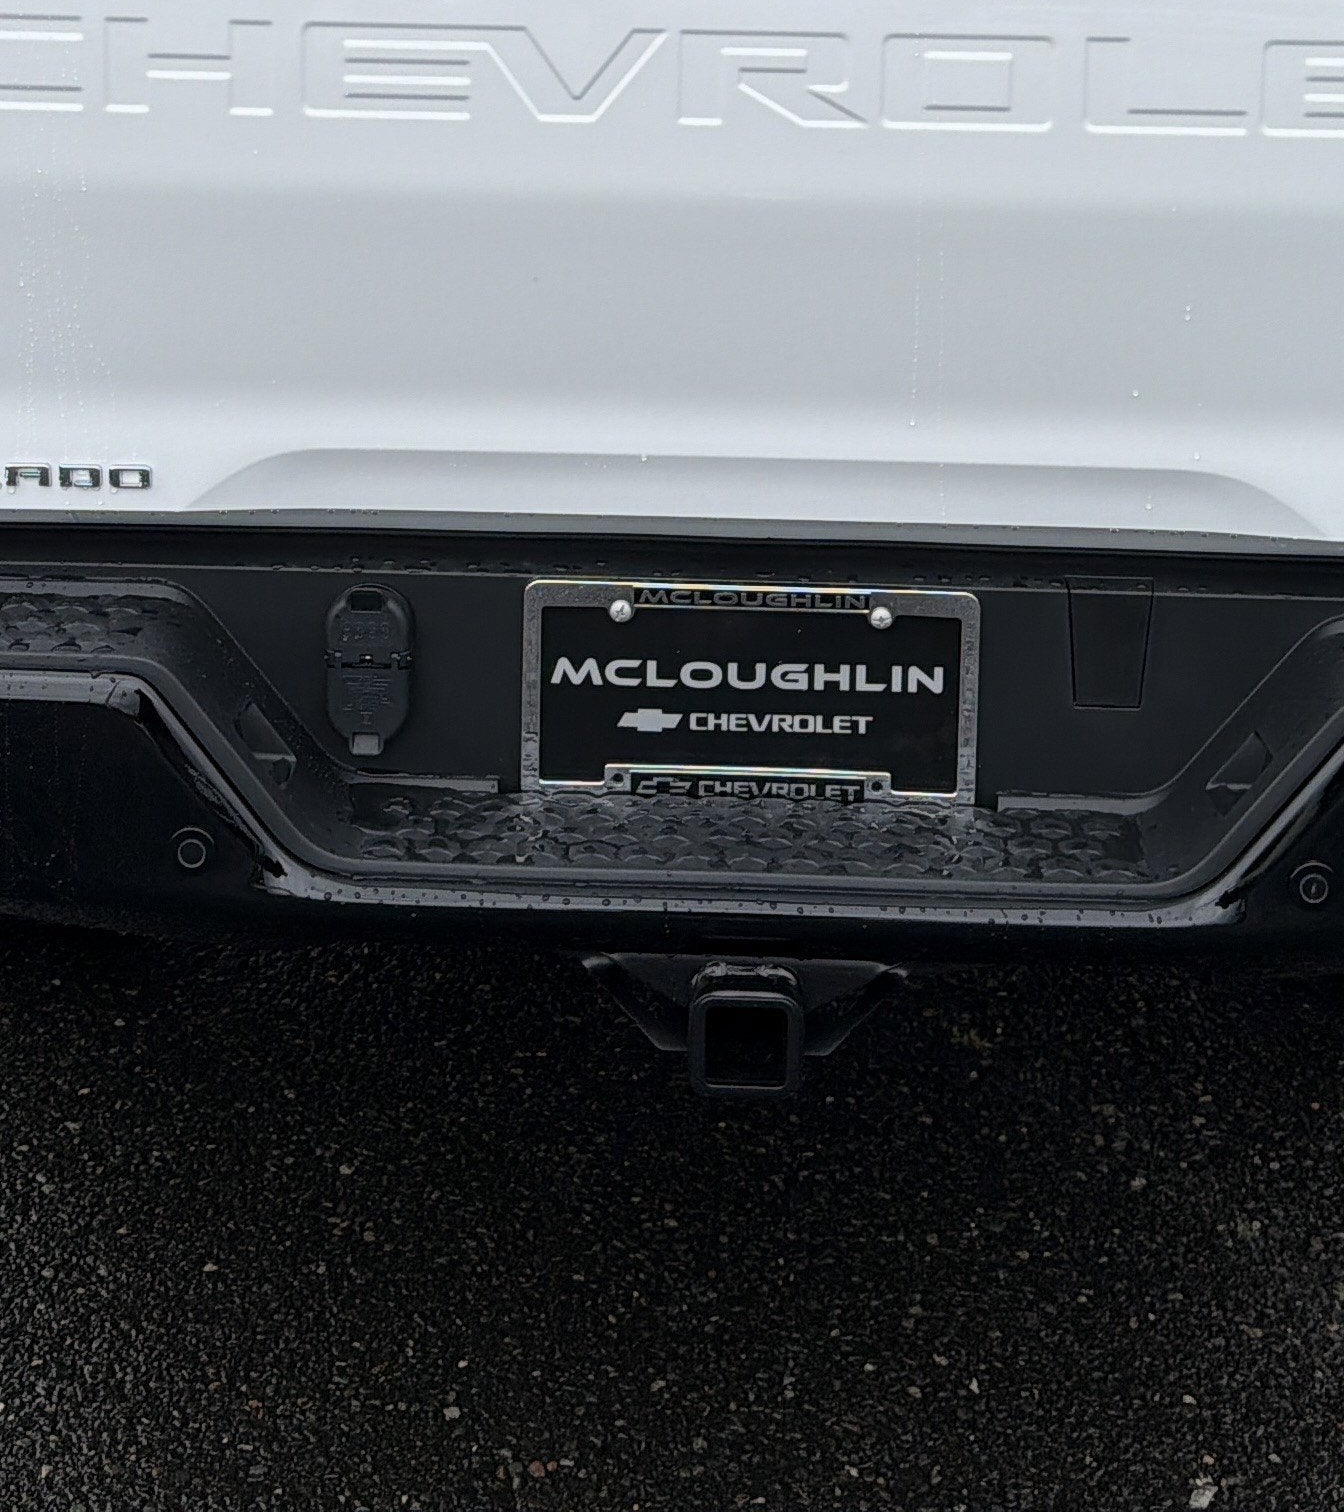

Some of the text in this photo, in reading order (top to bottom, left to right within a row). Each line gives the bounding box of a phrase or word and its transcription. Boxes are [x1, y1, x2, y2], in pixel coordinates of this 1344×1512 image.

[639, 589, 866, 609] MCLOUGHLIN
[550, 656, 945, 694] MCLOUGHLIN
[689, 711, 874, 735] CHEVROLET
[698, 780, 861, 802] CHEVROLET
